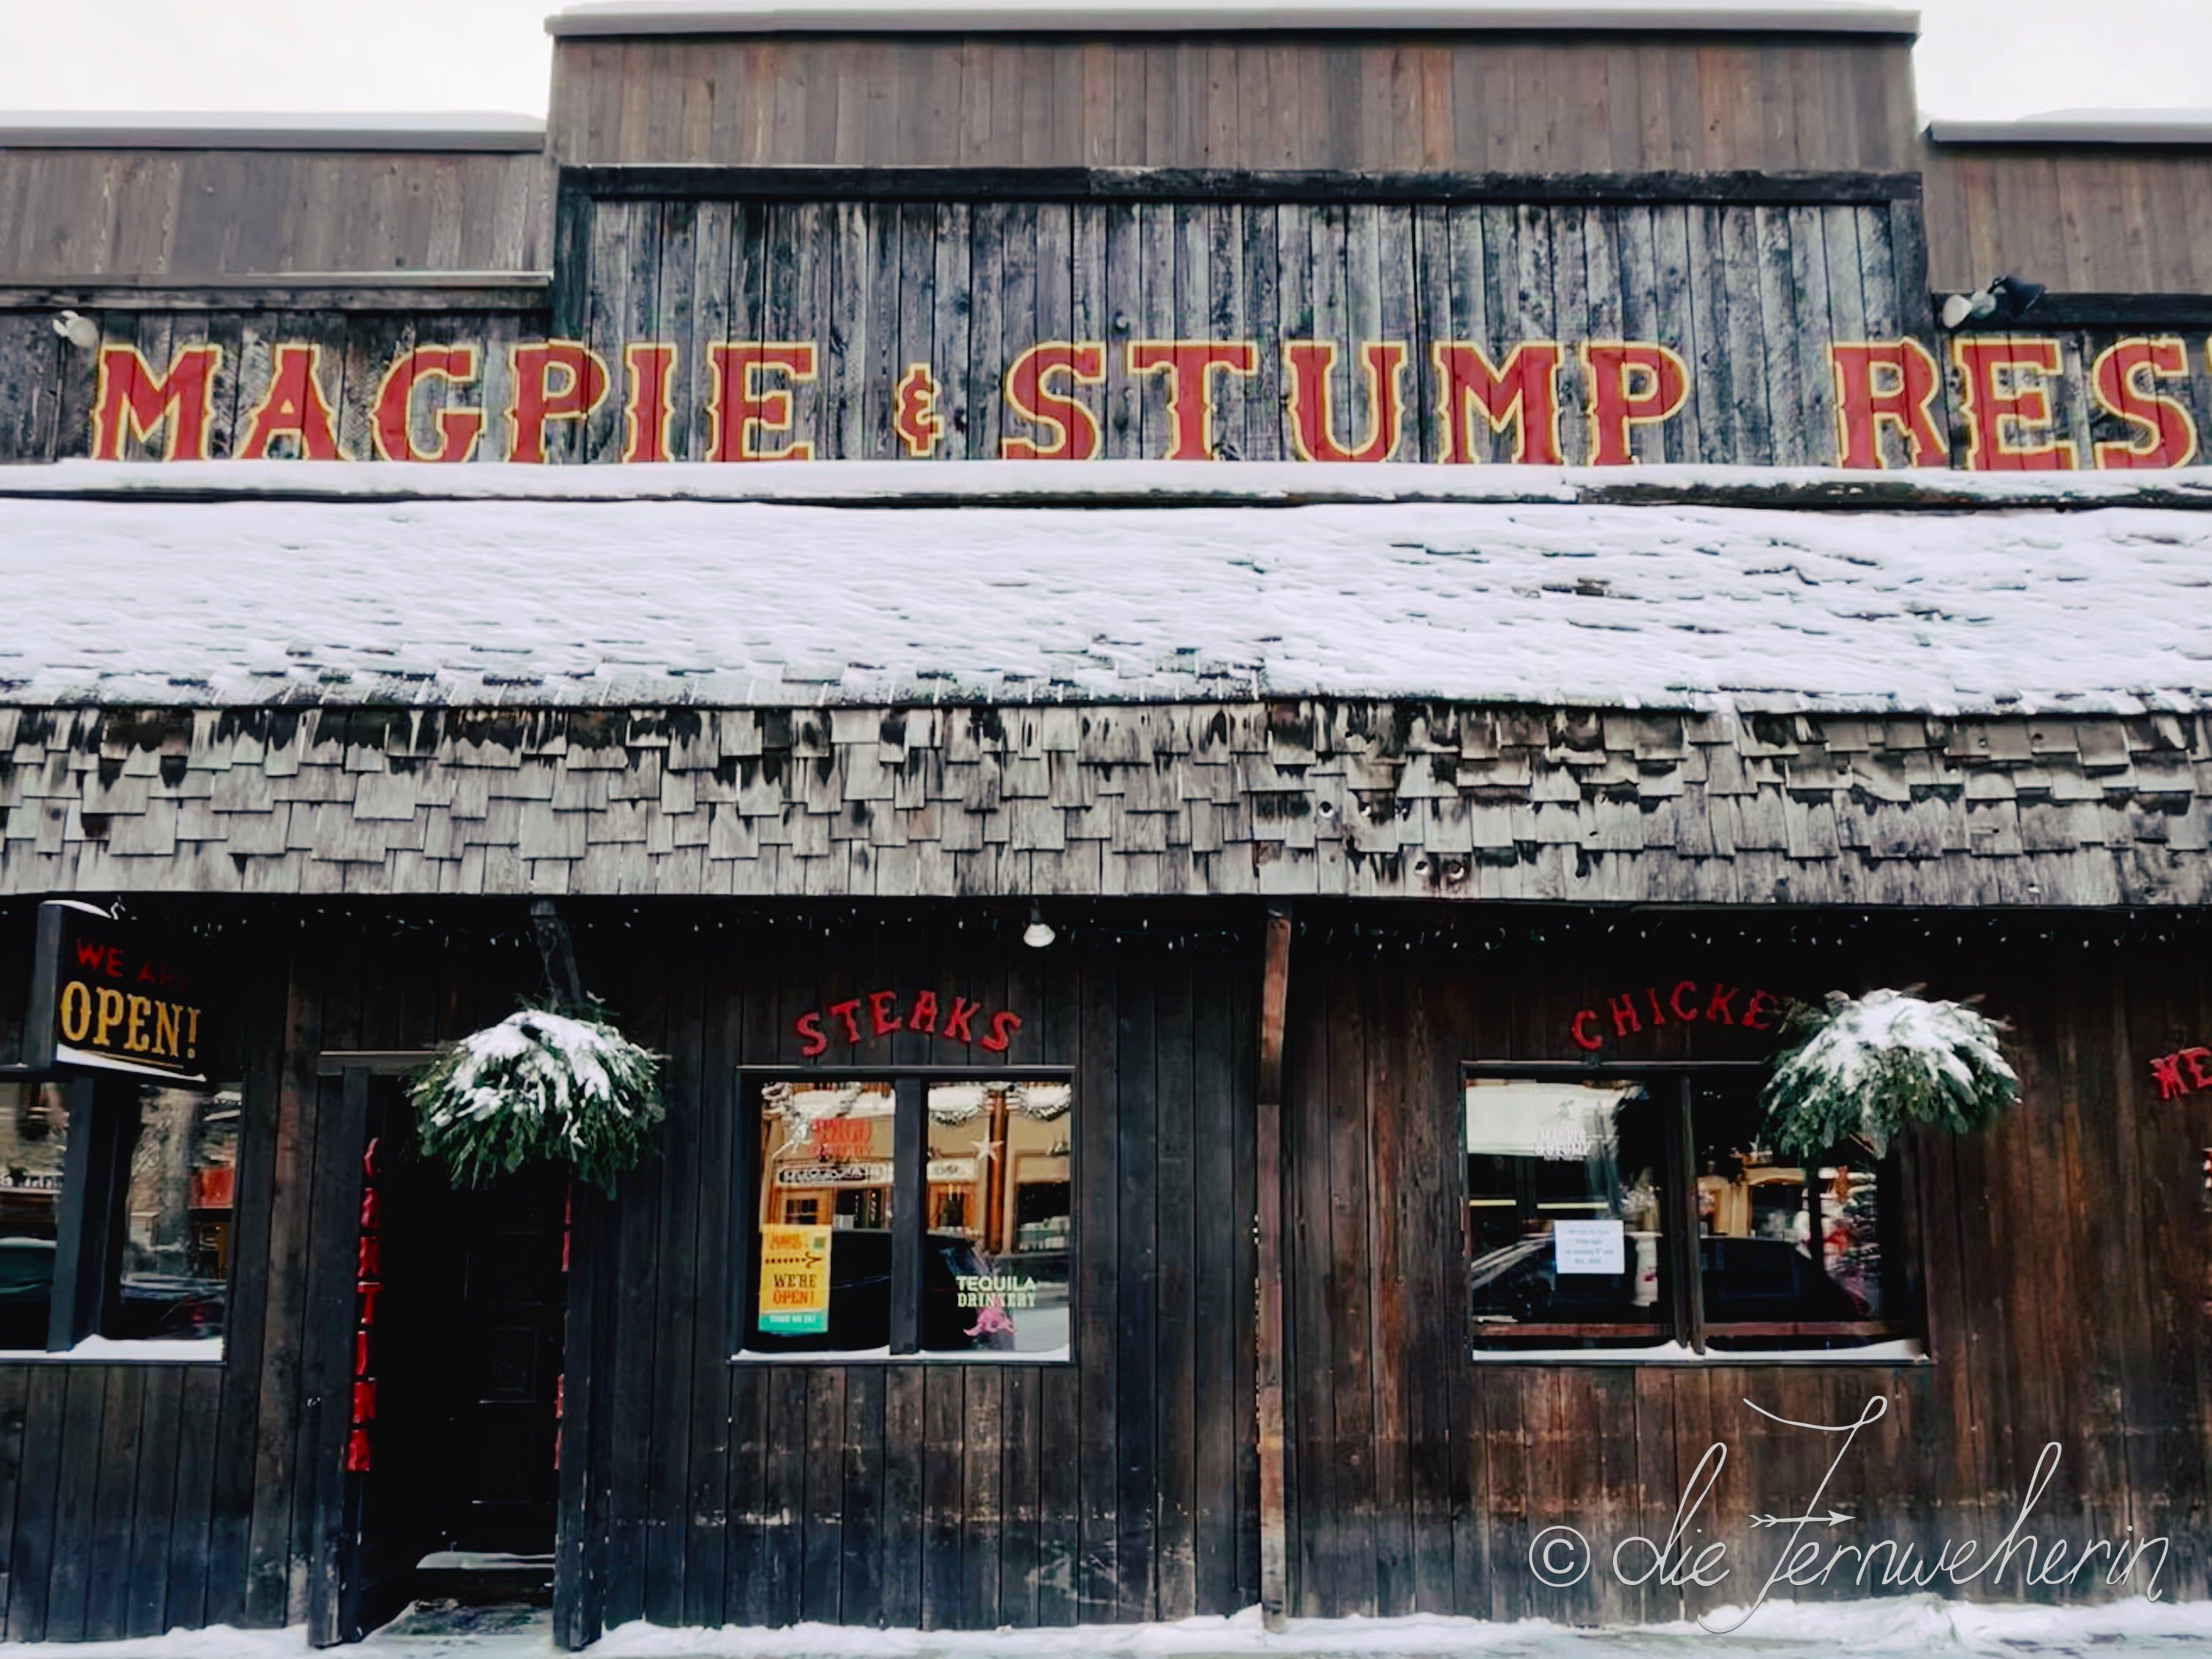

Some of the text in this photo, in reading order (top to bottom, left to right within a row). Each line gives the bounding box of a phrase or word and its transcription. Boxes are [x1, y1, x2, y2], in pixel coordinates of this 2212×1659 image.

[91, 336, 2212, 470] MAGPIE & STUMP RES
[75, 937, 124, 978] WE
[60, 980, 202, 1059] OPEN!
[794, 990, 1023, 1056] STEAKS
[1570, 980, 1780, 1052] CHICKE
[772, 1290, 815, 1304] OPEN!
[774, 1274, 817, 1288] WE'RE
[955, 1275, 1036, 1292] TEQUILA
[957, 1292, 1036, 1308] DRINKERY
